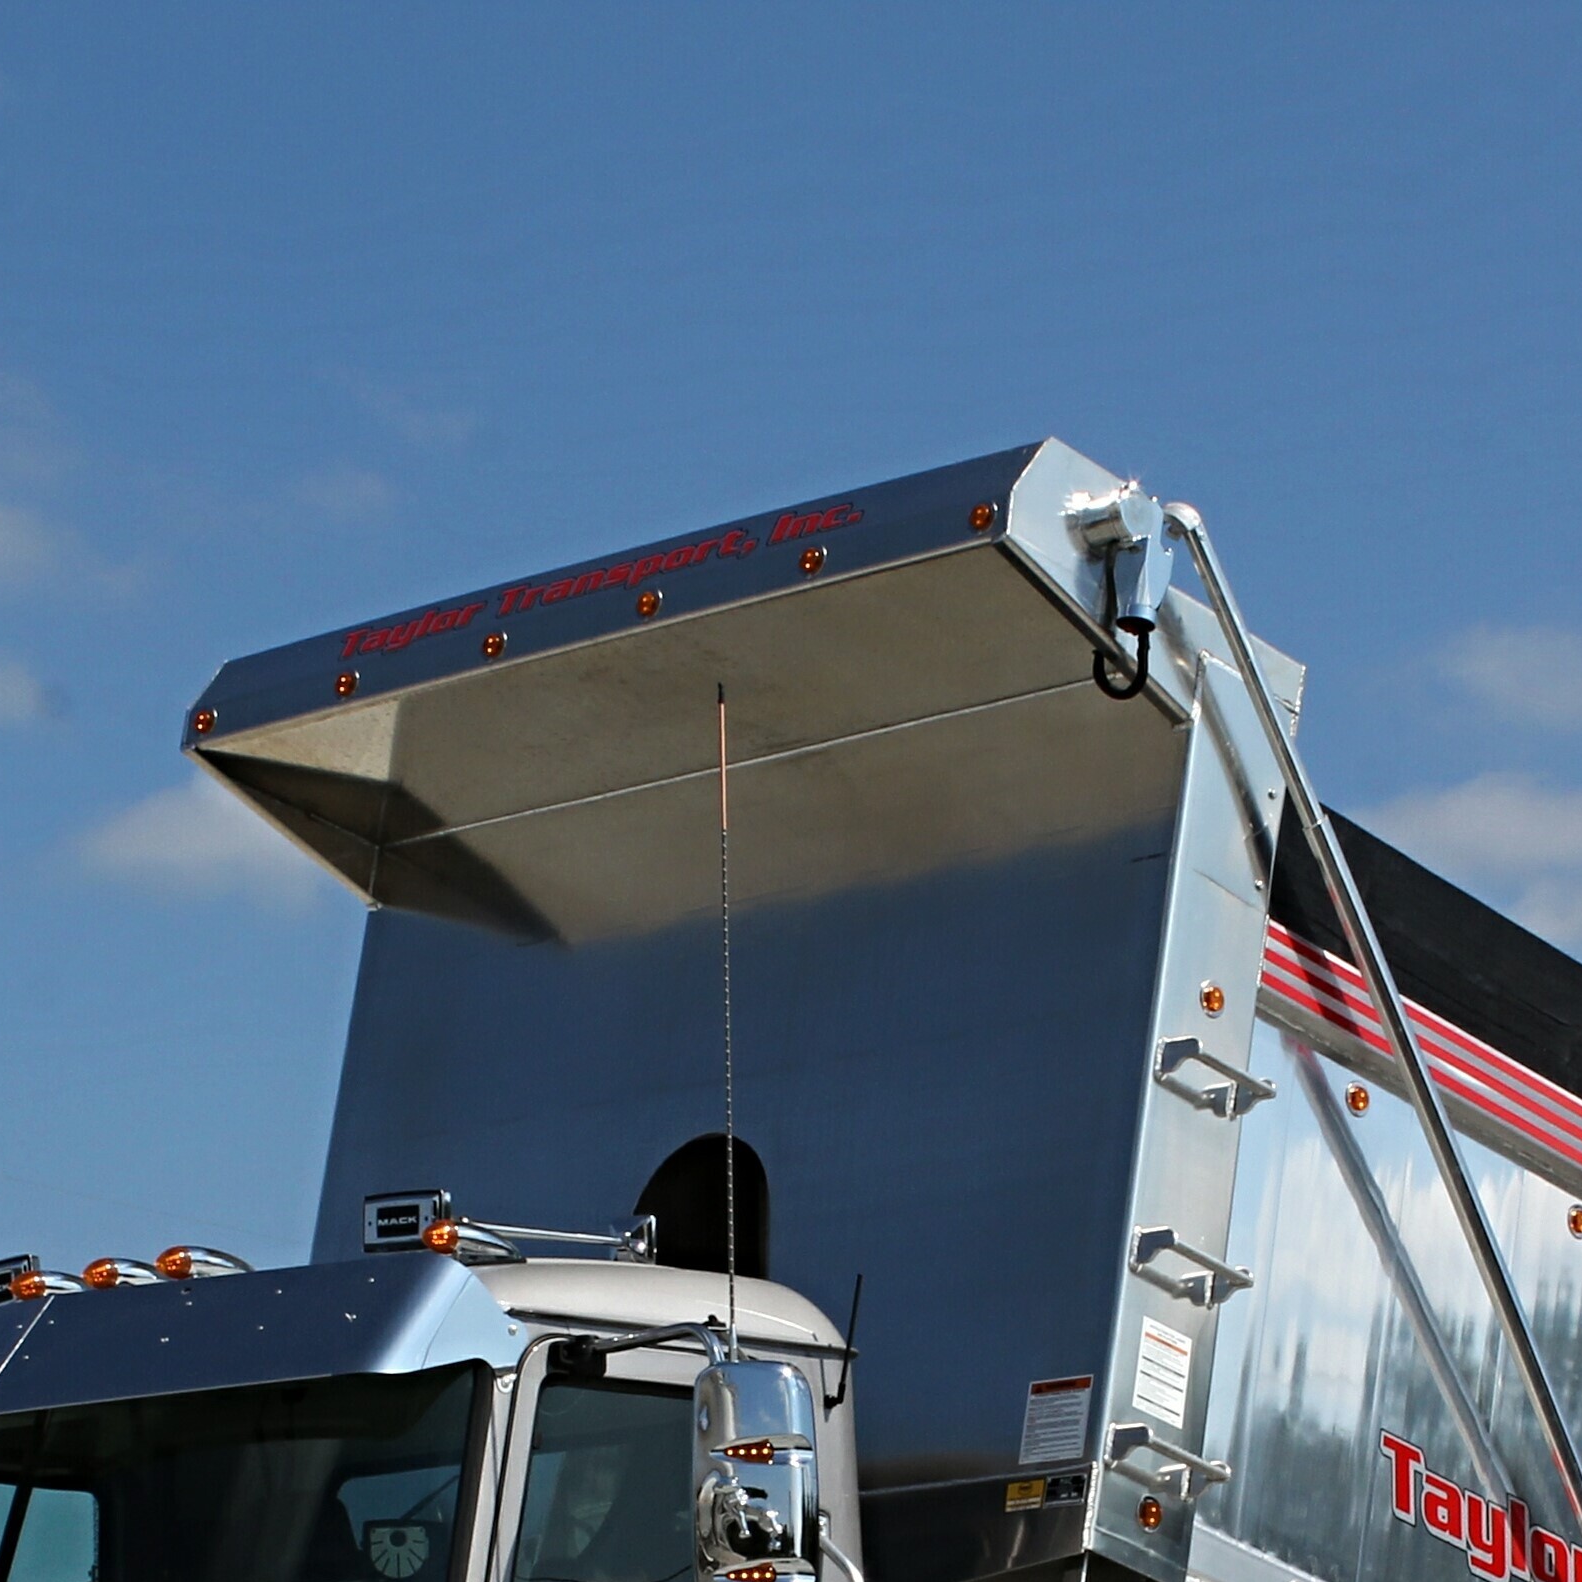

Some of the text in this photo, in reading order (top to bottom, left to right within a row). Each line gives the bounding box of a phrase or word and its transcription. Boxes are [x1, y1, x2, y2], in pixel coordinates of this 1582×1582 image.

[340, 503, 863, 658] Taylor Transport, Inc.
[377, 1215, 417, 1226] MACK
